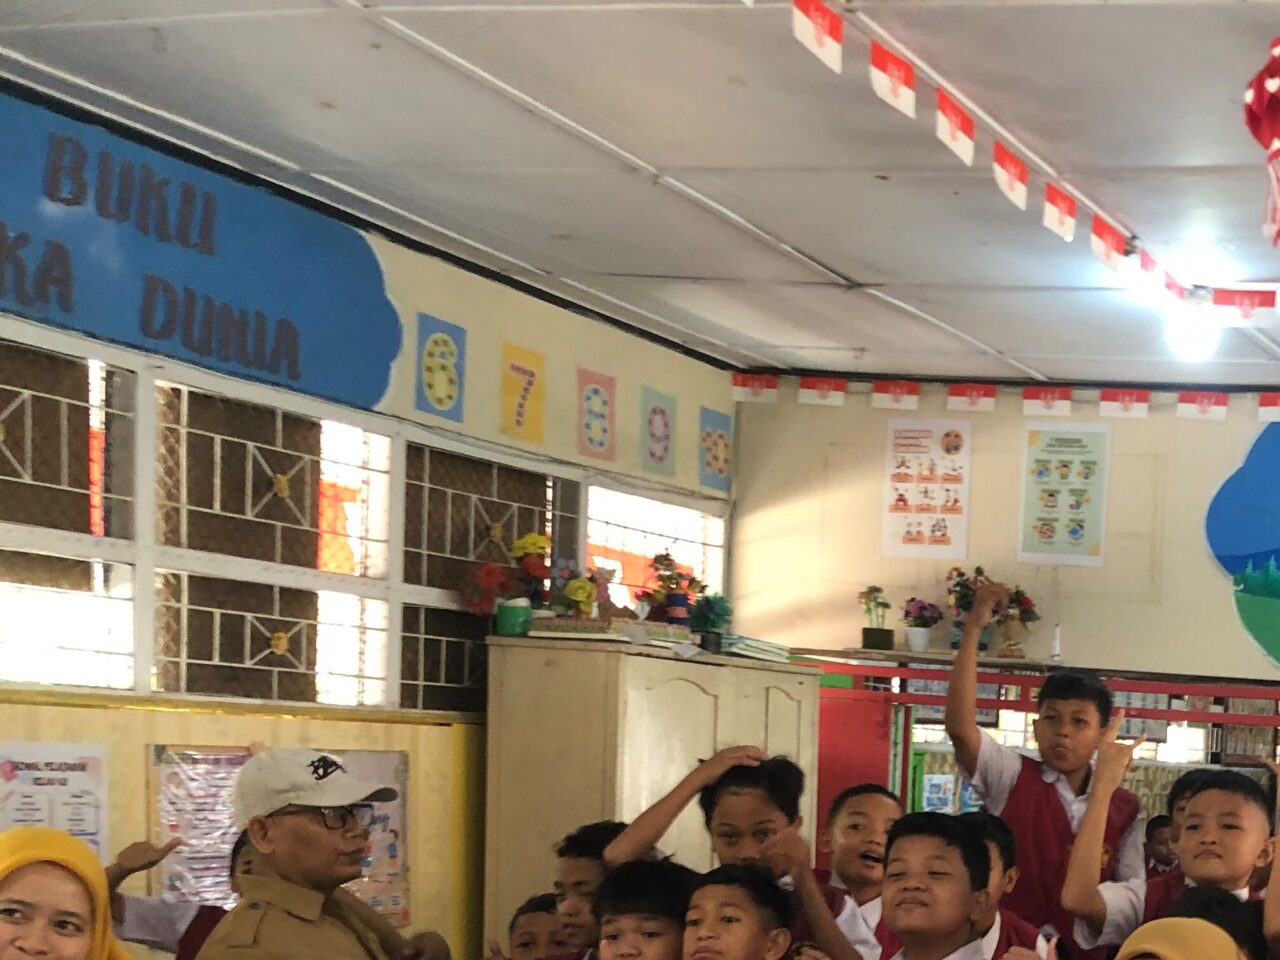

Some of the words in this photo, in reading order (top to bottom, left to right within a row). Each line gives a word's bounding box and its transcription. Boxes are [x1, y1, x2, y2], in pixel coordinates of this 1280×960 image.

[44, 132, 217, 256] BUKU
[140, 274, 300, 381] DUNIA
[423, 332, 458, 411] 6
[509, 362, 537, 428] 7
[583, 384, 609, 451] 8
[647, 405, 672, 465] 9
